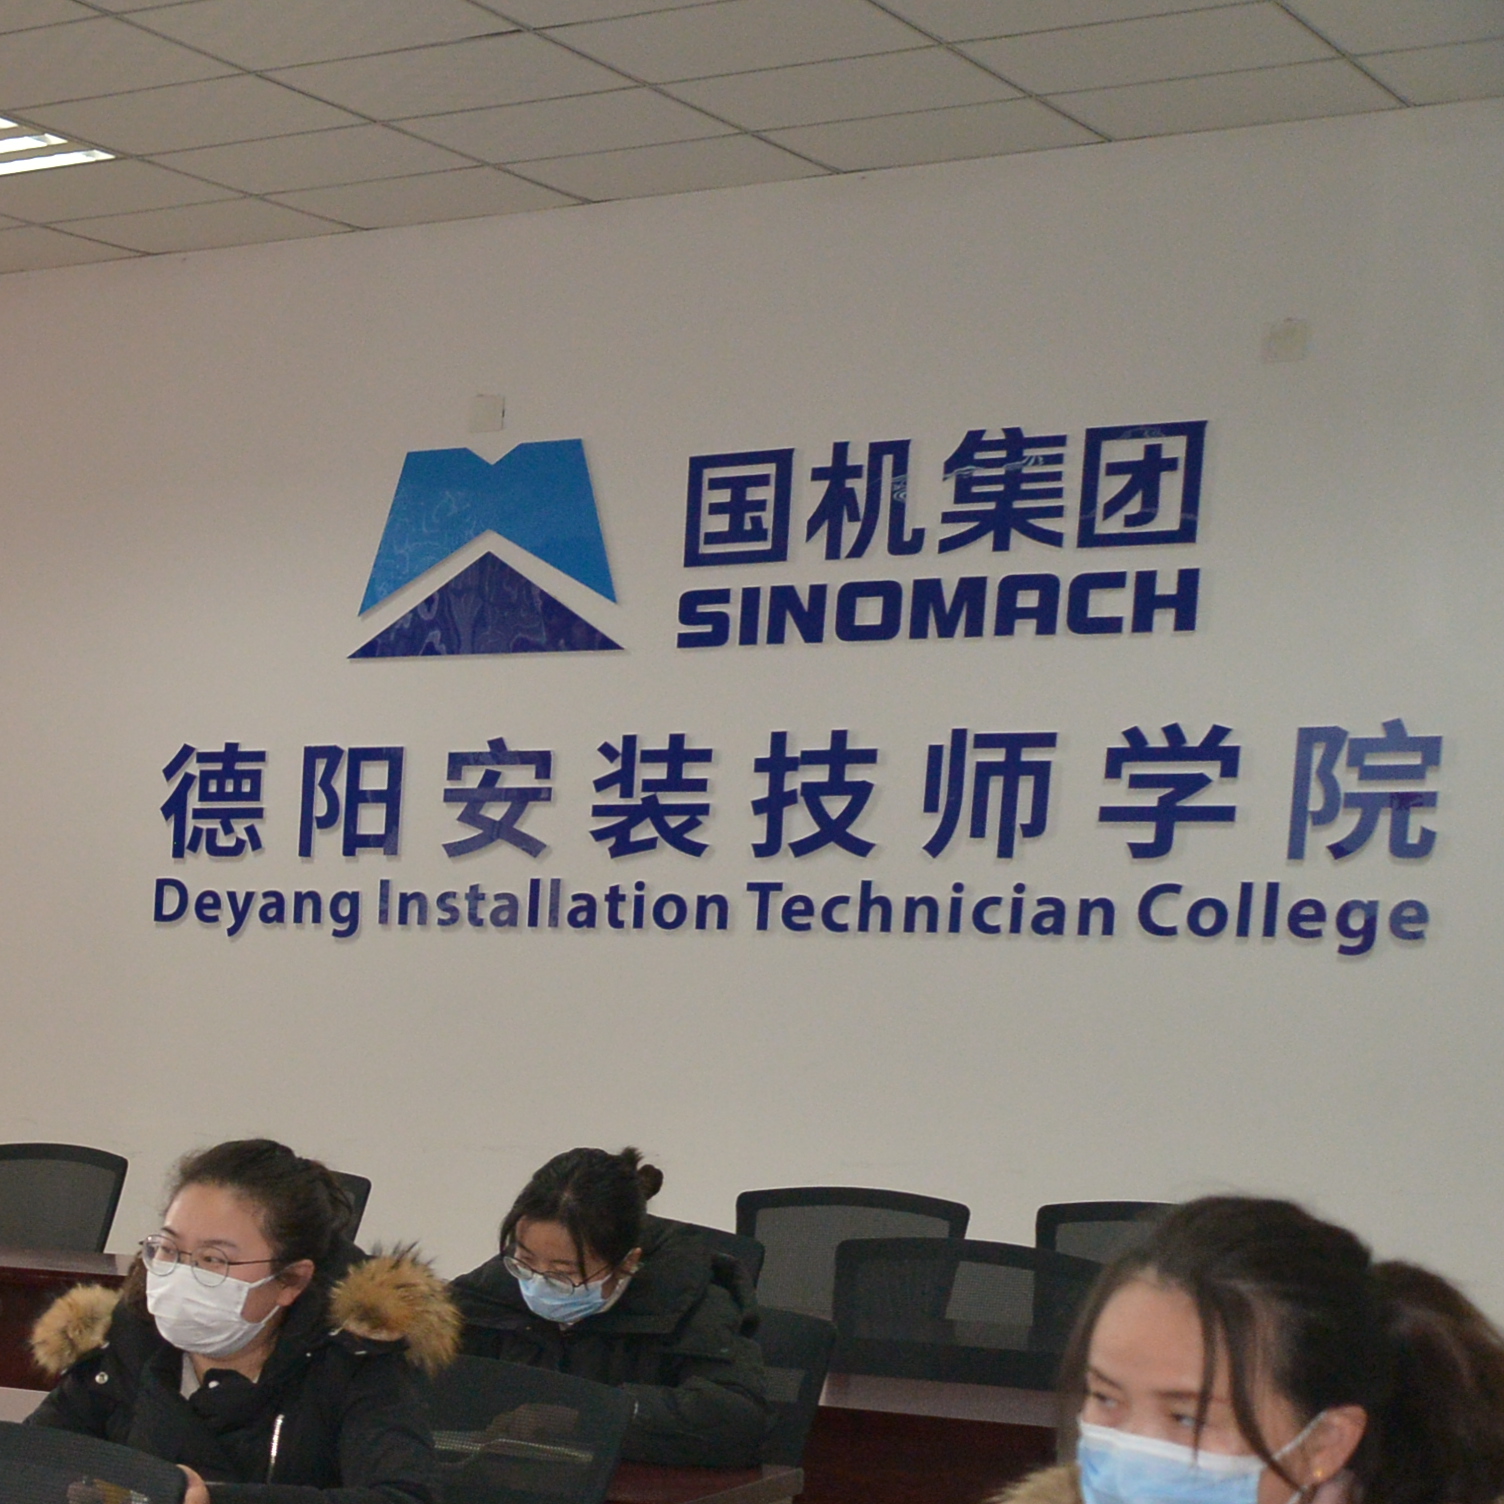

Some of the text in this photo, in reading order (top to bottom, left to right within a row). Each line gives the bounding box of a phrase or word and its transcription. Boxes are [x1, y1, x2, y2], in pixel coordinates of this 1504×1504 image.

[682, 419, 1209, 568] 国机集团
[676, 567, 1201, 649] SINOMACH
[160, 718, 1445, 862] 德阳安装技师学院
[152, 877, 1431, 956] Deyang Installation Technician College
